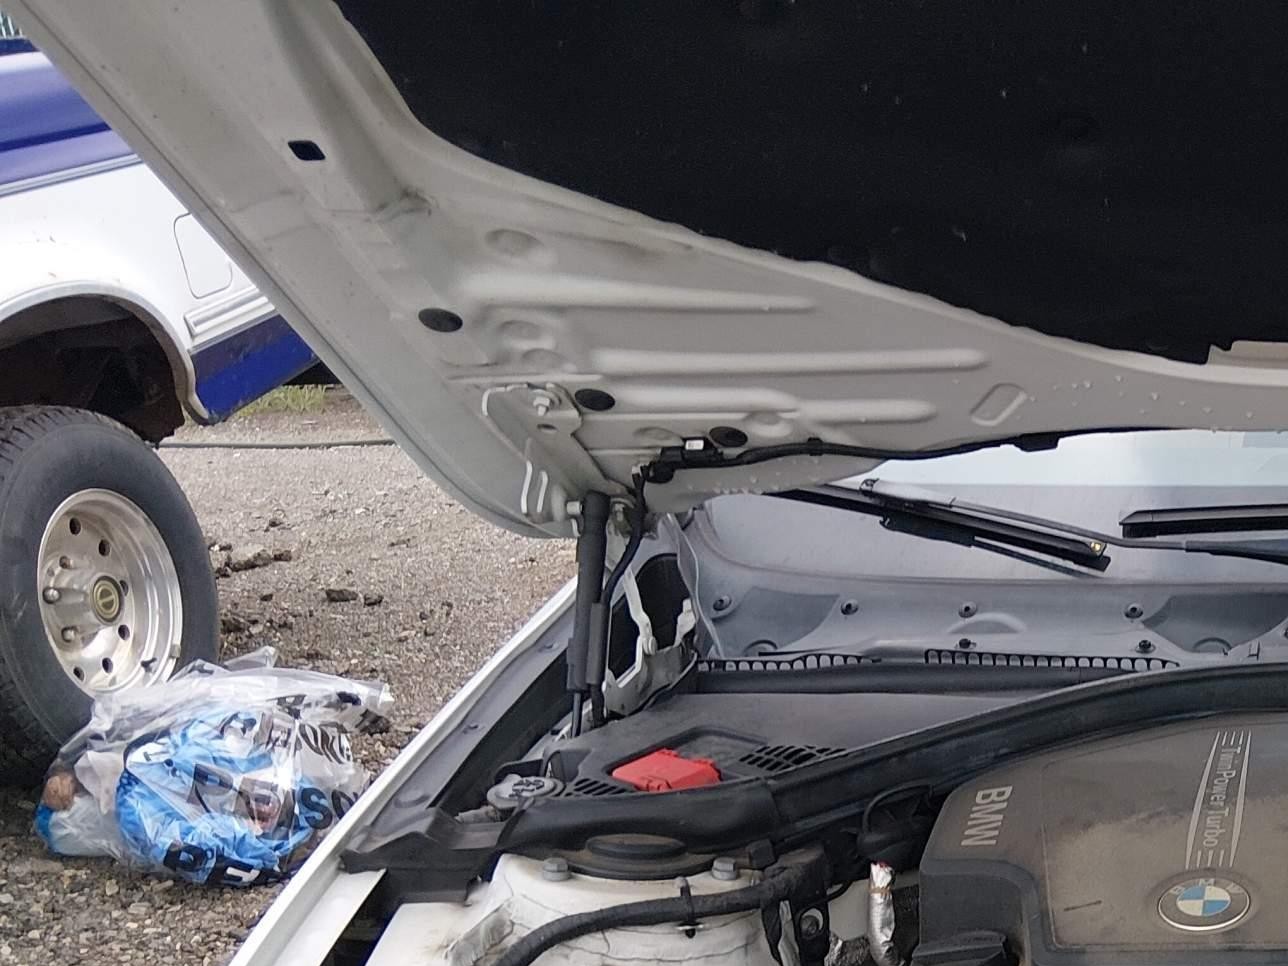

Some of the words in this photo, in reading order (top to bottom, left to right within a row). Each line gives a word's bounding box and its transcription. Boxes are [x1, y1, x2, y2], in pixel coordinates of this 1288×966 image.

[1209, 747, 1241, 806] TwinPower
[961, 786, 1013, 846] BMW
[1203, 807, 1230, 847] Turbo
